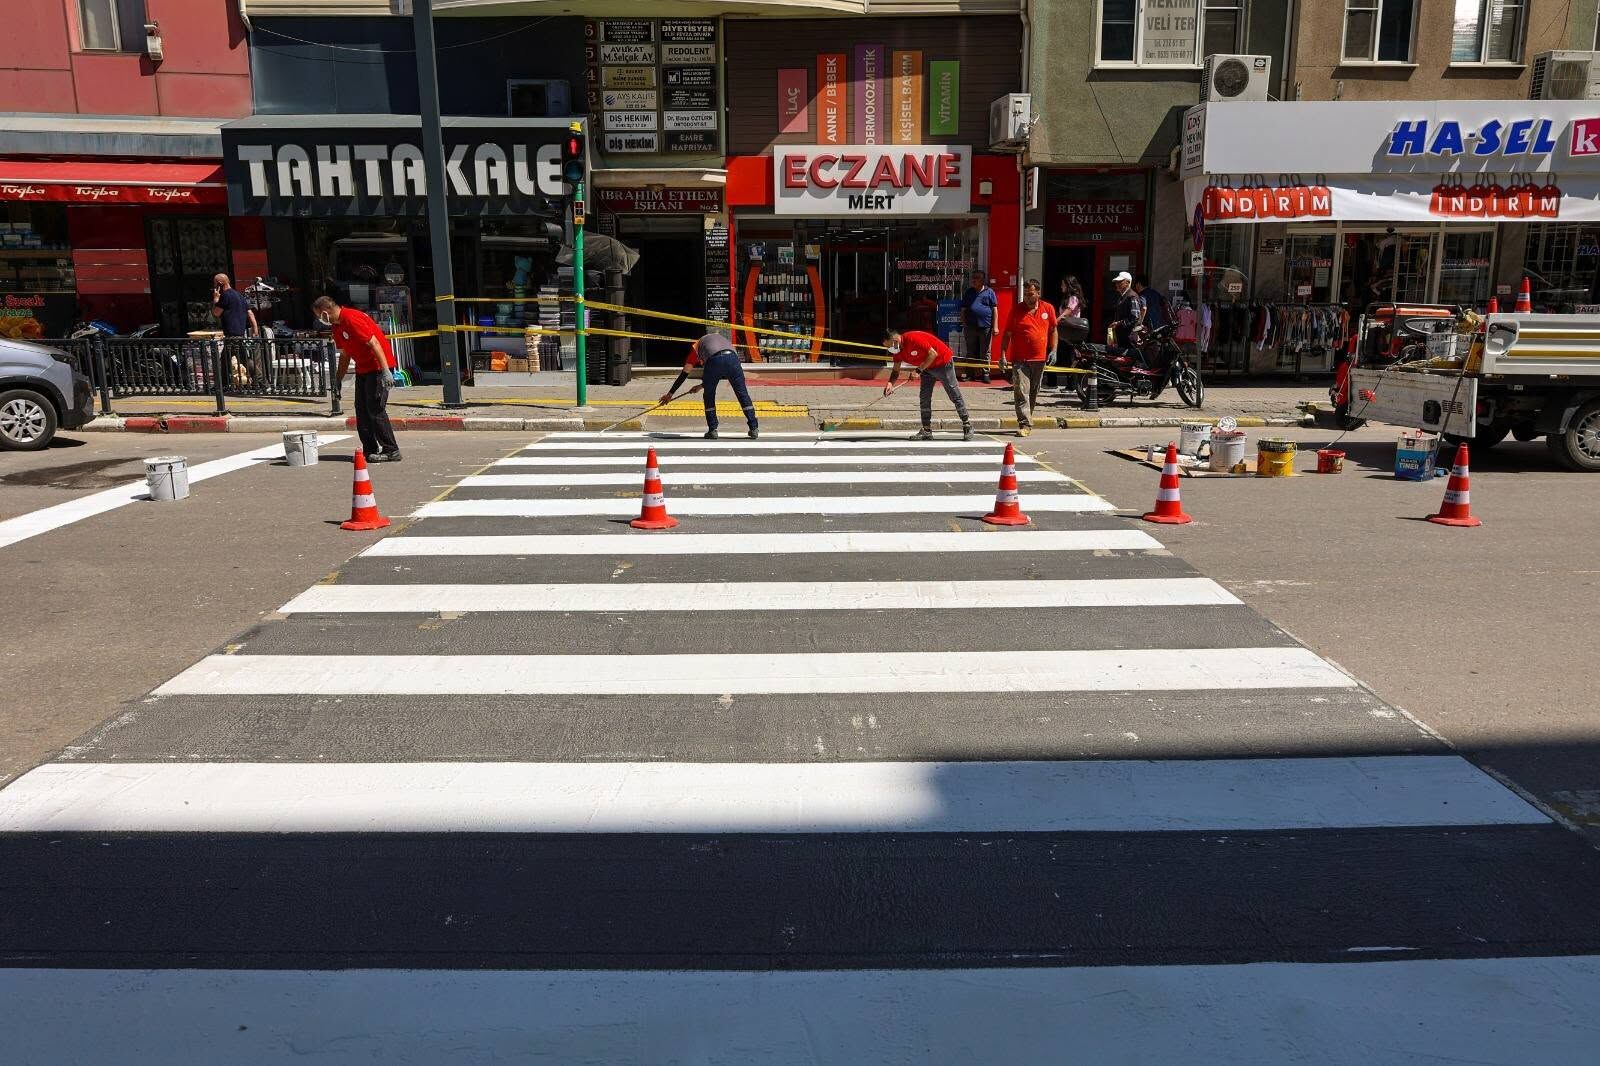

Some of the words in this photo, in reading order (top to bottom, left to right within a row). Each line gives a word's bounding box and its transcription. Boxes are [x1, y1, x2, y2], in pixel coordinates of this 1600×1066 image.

[1147, 13, 1171, 30] VELİ
[585, 24, 593, 36] 6
[586, 47, 594, 58] 5
[642, 53, 653, 61] AY
[587, 69, 595, 80] 4
[826, 57, 837, 97] BEBEK
[901, 54, 913, 95] BAKIM
[786, 87, 800, 116] İLAÇ
[864, 49, 876, 145] DERMOKOZMETİK
[939, 71, 951, 125] VİTAMİN
[610, 114, 623, 123] DİŞ
[827, 106, 837, 142] ANNE
[900, 96, 914, 141] KİŞİSEL
[609, 137, 623, 150] DİŞ
[625, 136, 654, 149] HEKİMİ
[1387, 118, 1556, 156] HA-SEL
[237, 143, 562, 197] TAHTAKALE
[784, 153, 962, 189] ECZANE
[1, 185, 45, 198] Tuğba
[75, 186, 119, 199] Tuğba
[147, 188, 191, 200] Tuğba
[669, 190, 719, 201] ETHEM
[634, 200, 684, 212] İŞHANI
[848, 194, 896, 210] MERT
[1057, 203, 1136, 214] BEYLERCE
[1206, 192, 1329, 214] İNDİRİM
[1438, 192, 1557, 212] İNDİRİM
[1071, 213, 1120, 225] İŞHANI
